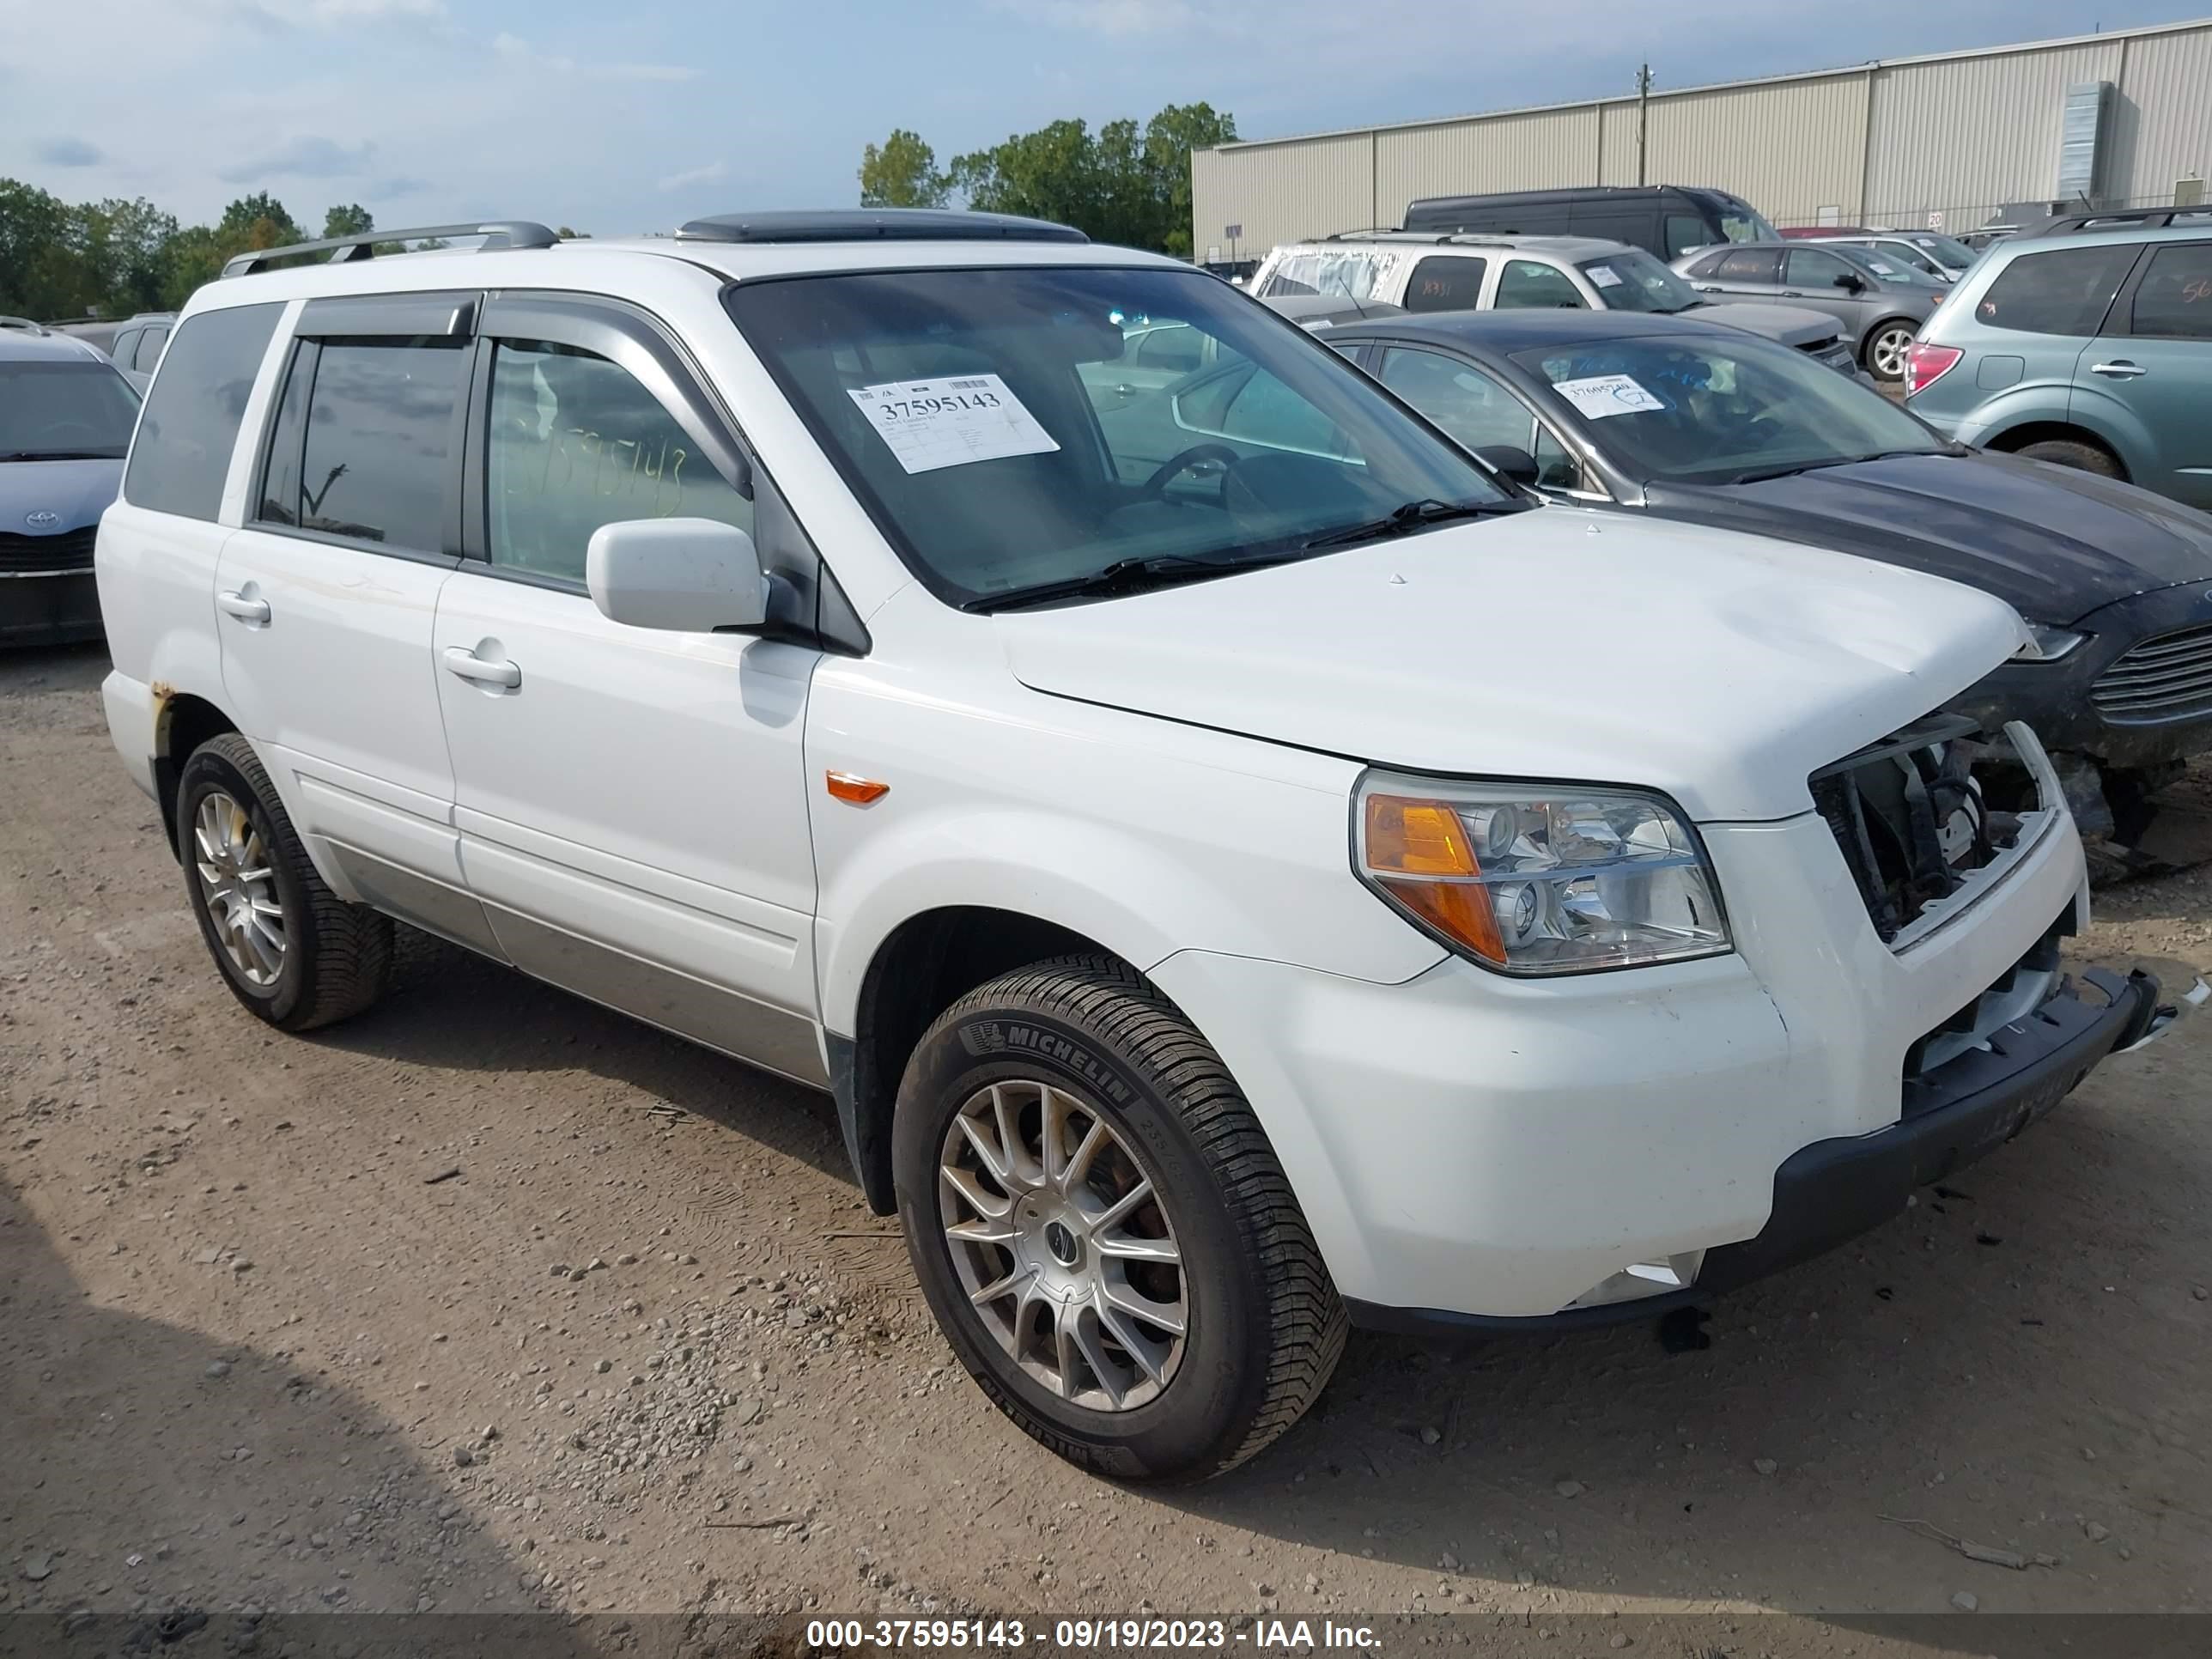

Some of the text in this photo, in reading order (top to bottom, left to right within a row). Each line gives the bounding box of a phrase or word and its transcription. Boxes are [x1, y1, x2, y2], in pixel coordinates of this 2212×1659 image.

[1929, 215, 1942, 226] 20
[879, 392, 1001, 421] 37595143
[1008, 1026, 1131, 1104] MICHELIN
